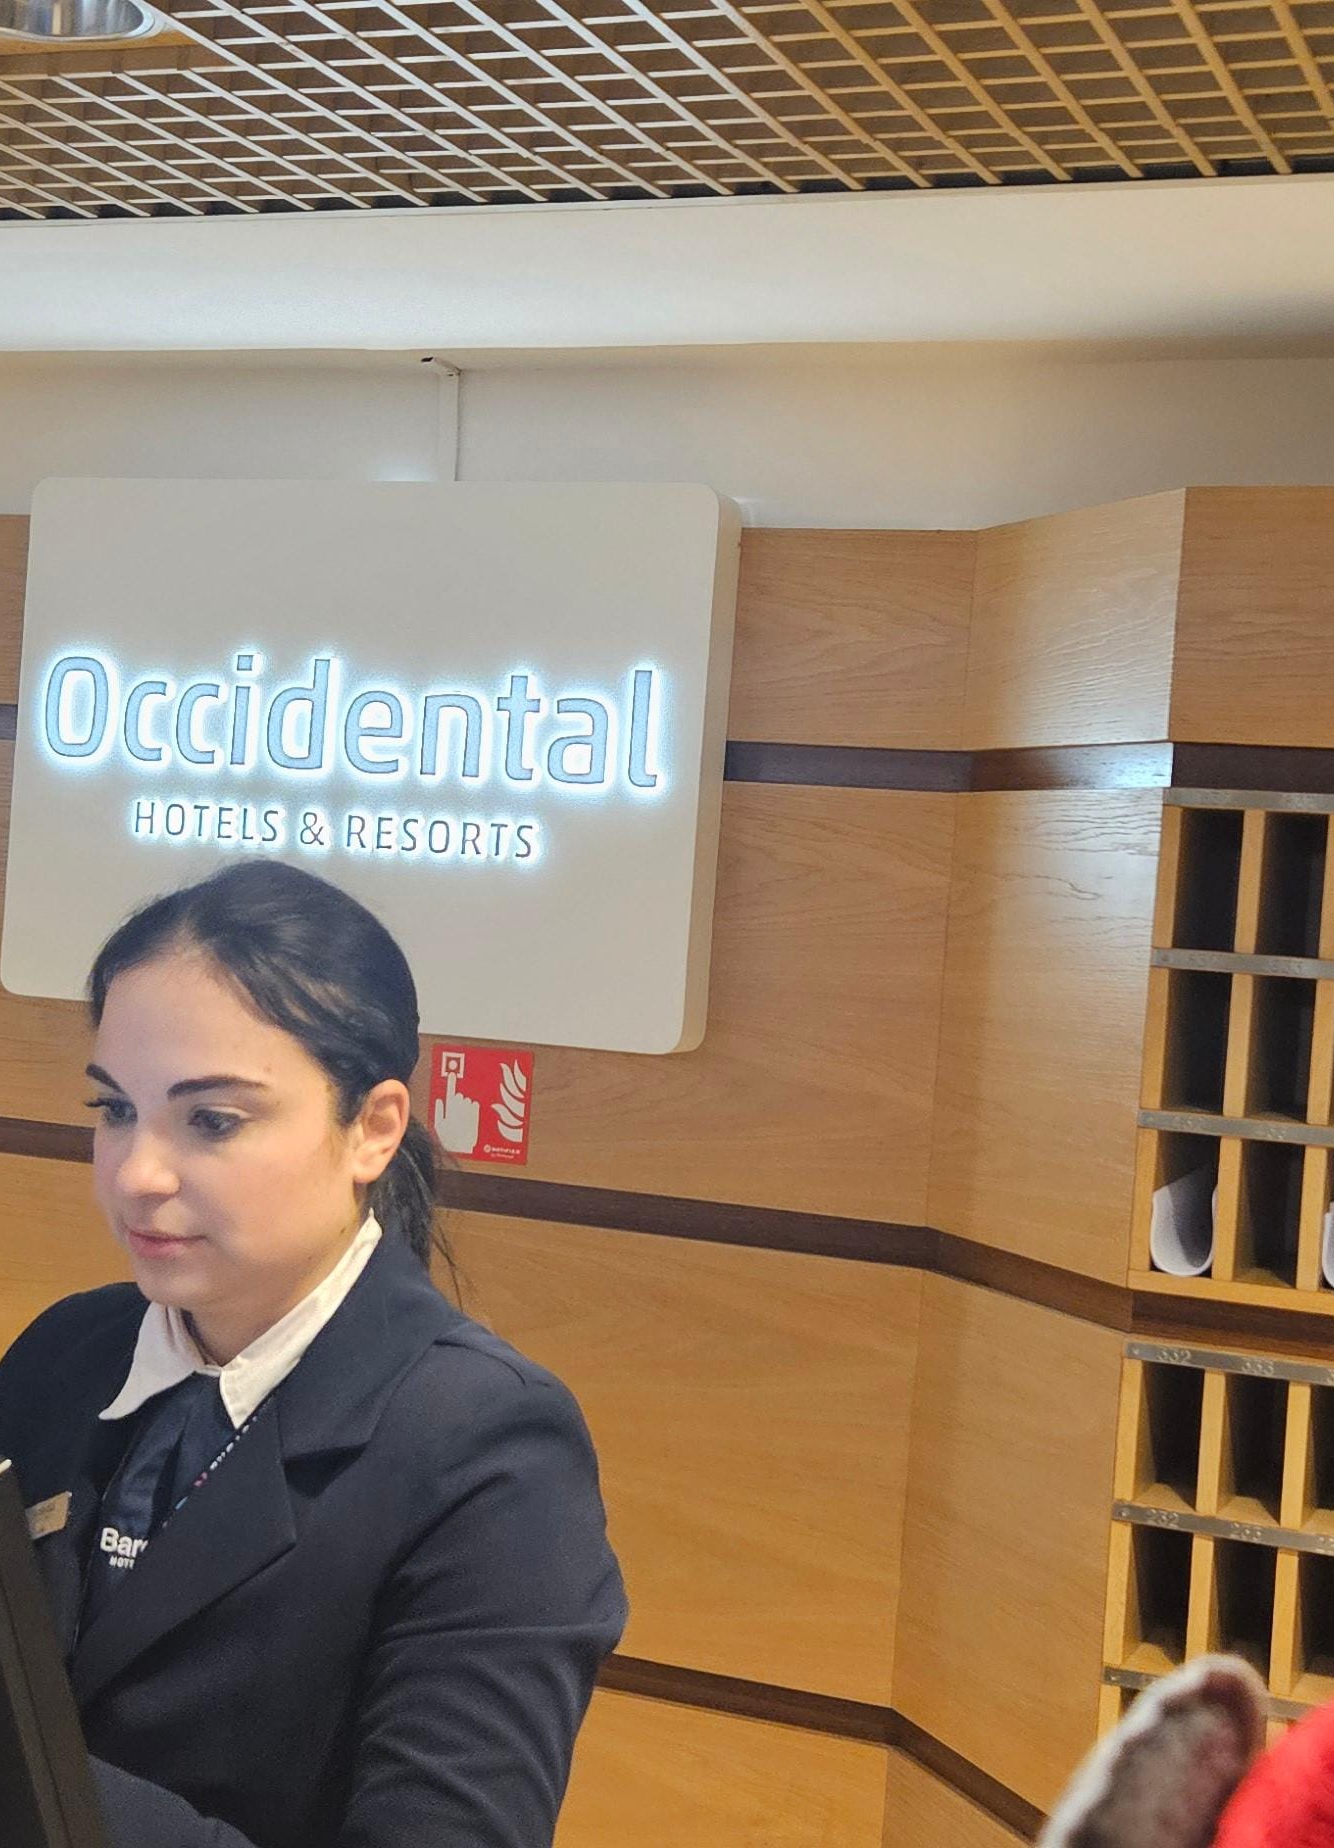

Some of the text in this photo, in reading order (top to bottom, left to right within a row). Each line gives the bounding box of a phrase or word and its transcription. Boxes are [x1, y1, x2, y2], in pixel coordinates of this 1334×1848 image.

[45, 655, 660, 788] Occidental
[134, 801, 537, 858] HOTELS & RESORTS
